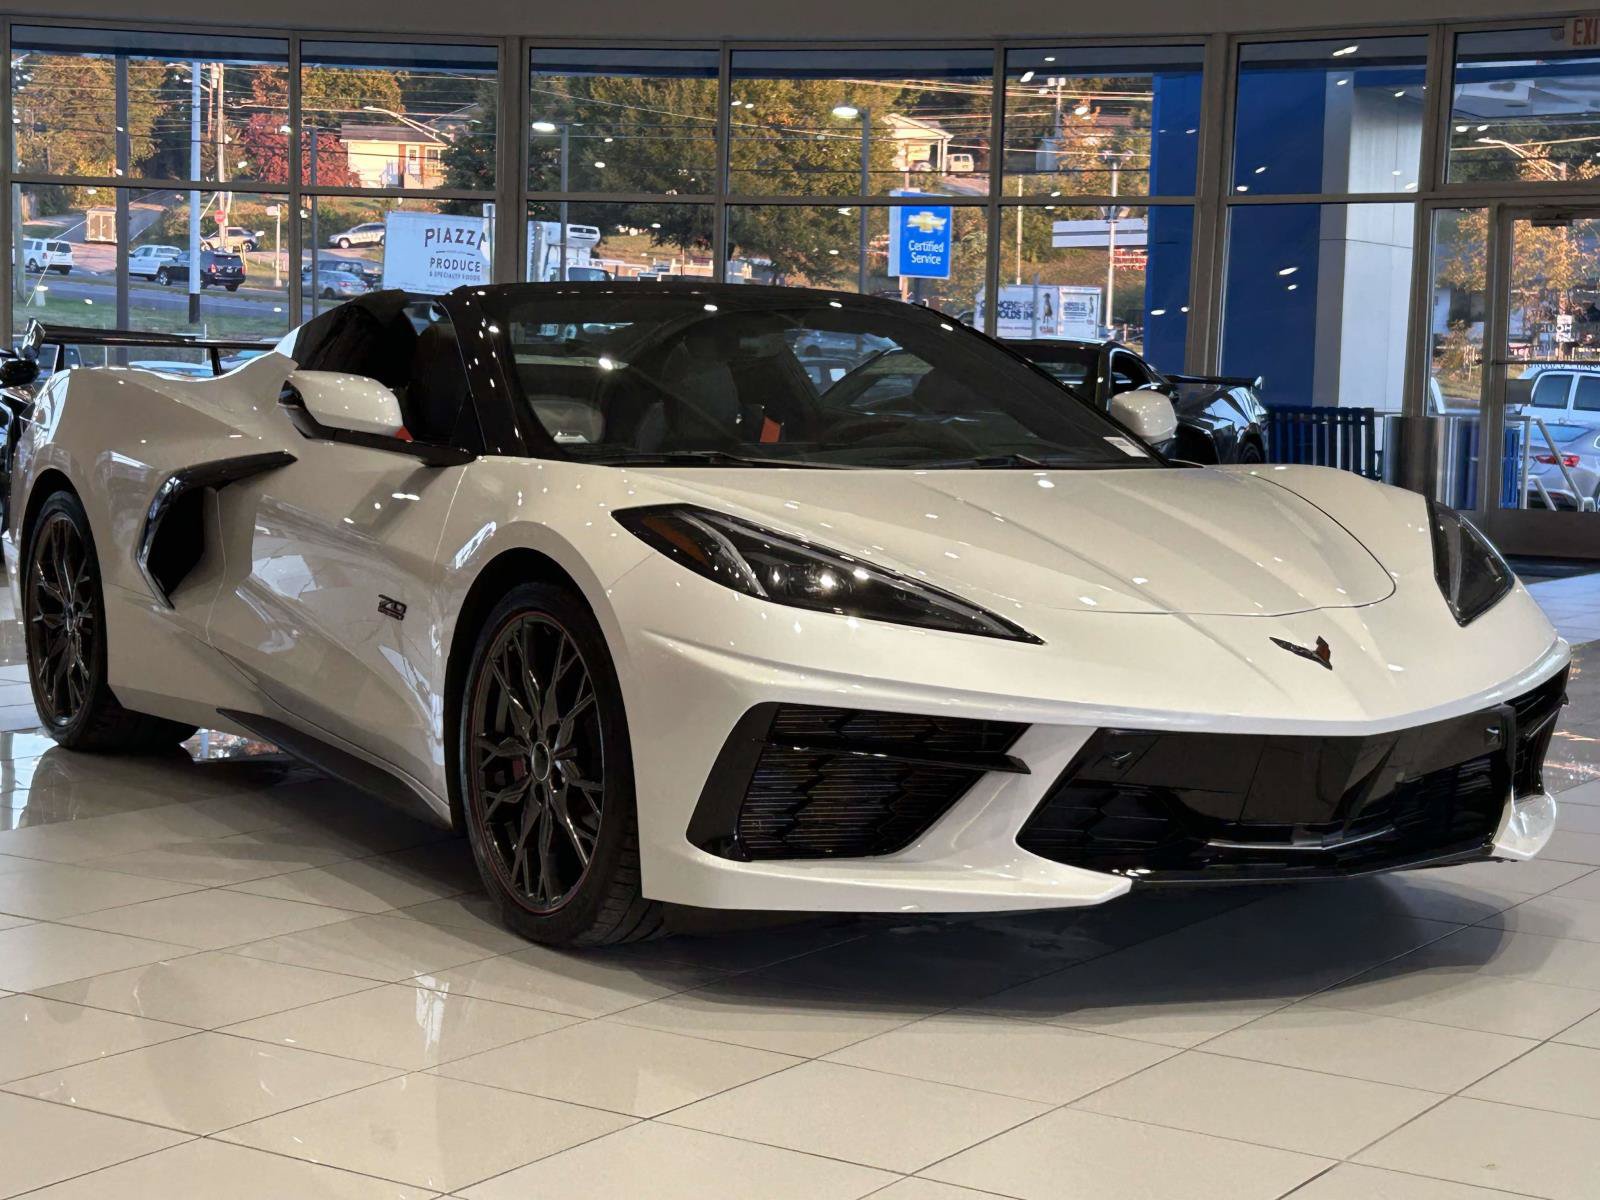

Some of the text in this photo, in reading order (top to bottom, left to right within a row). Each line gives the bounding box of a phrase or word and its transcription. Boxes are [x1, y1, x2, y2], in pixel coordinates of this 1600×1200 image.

[1572, 17, 1600, 45] EXI
[424, 228, 487, 250] PIAZZA
[908, 239, 945, 252] Certified
[429, 257, 481, 272] PRODUCE
[911, 252, 942, 265] Service
